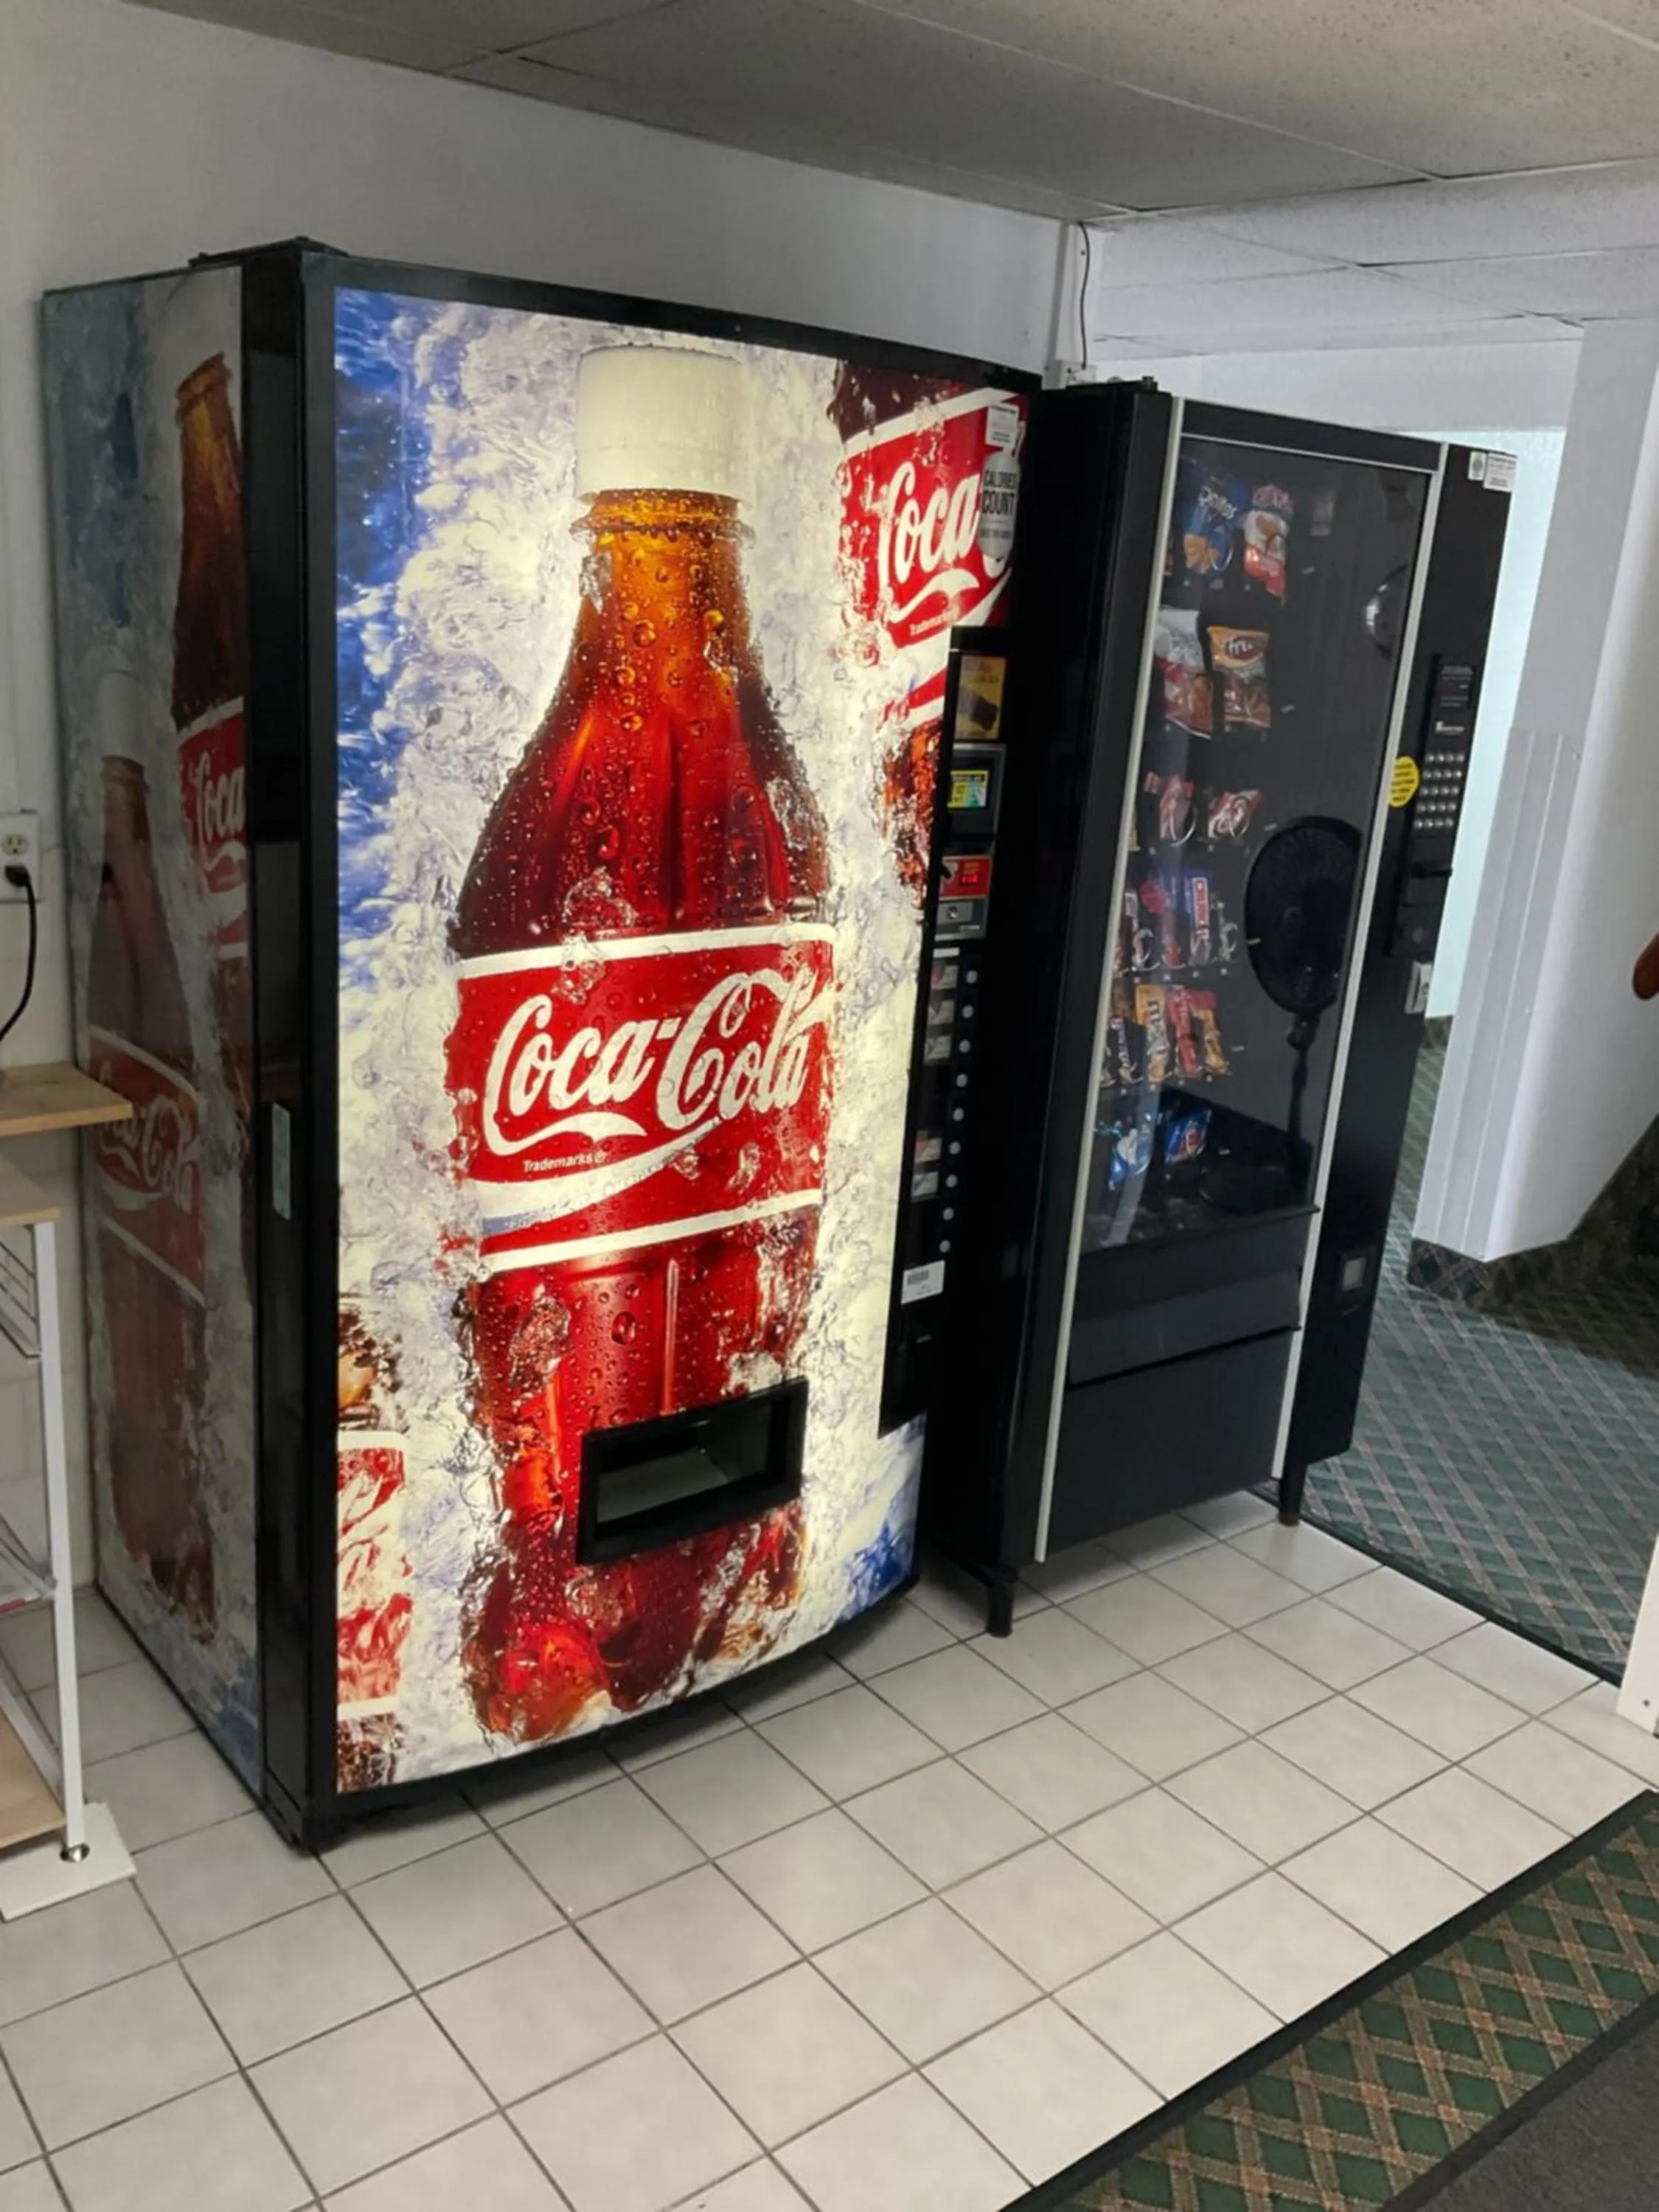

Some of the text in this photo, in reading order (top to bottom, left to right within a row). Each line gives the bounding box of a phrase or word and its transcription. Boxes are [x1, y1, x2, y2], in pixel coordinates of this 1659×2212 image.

[982, 490, 1016, 516] COUNT
[1198, 484, 1238, 520] Doritos
[483, 965, 835, 1156] Coca-Cola
